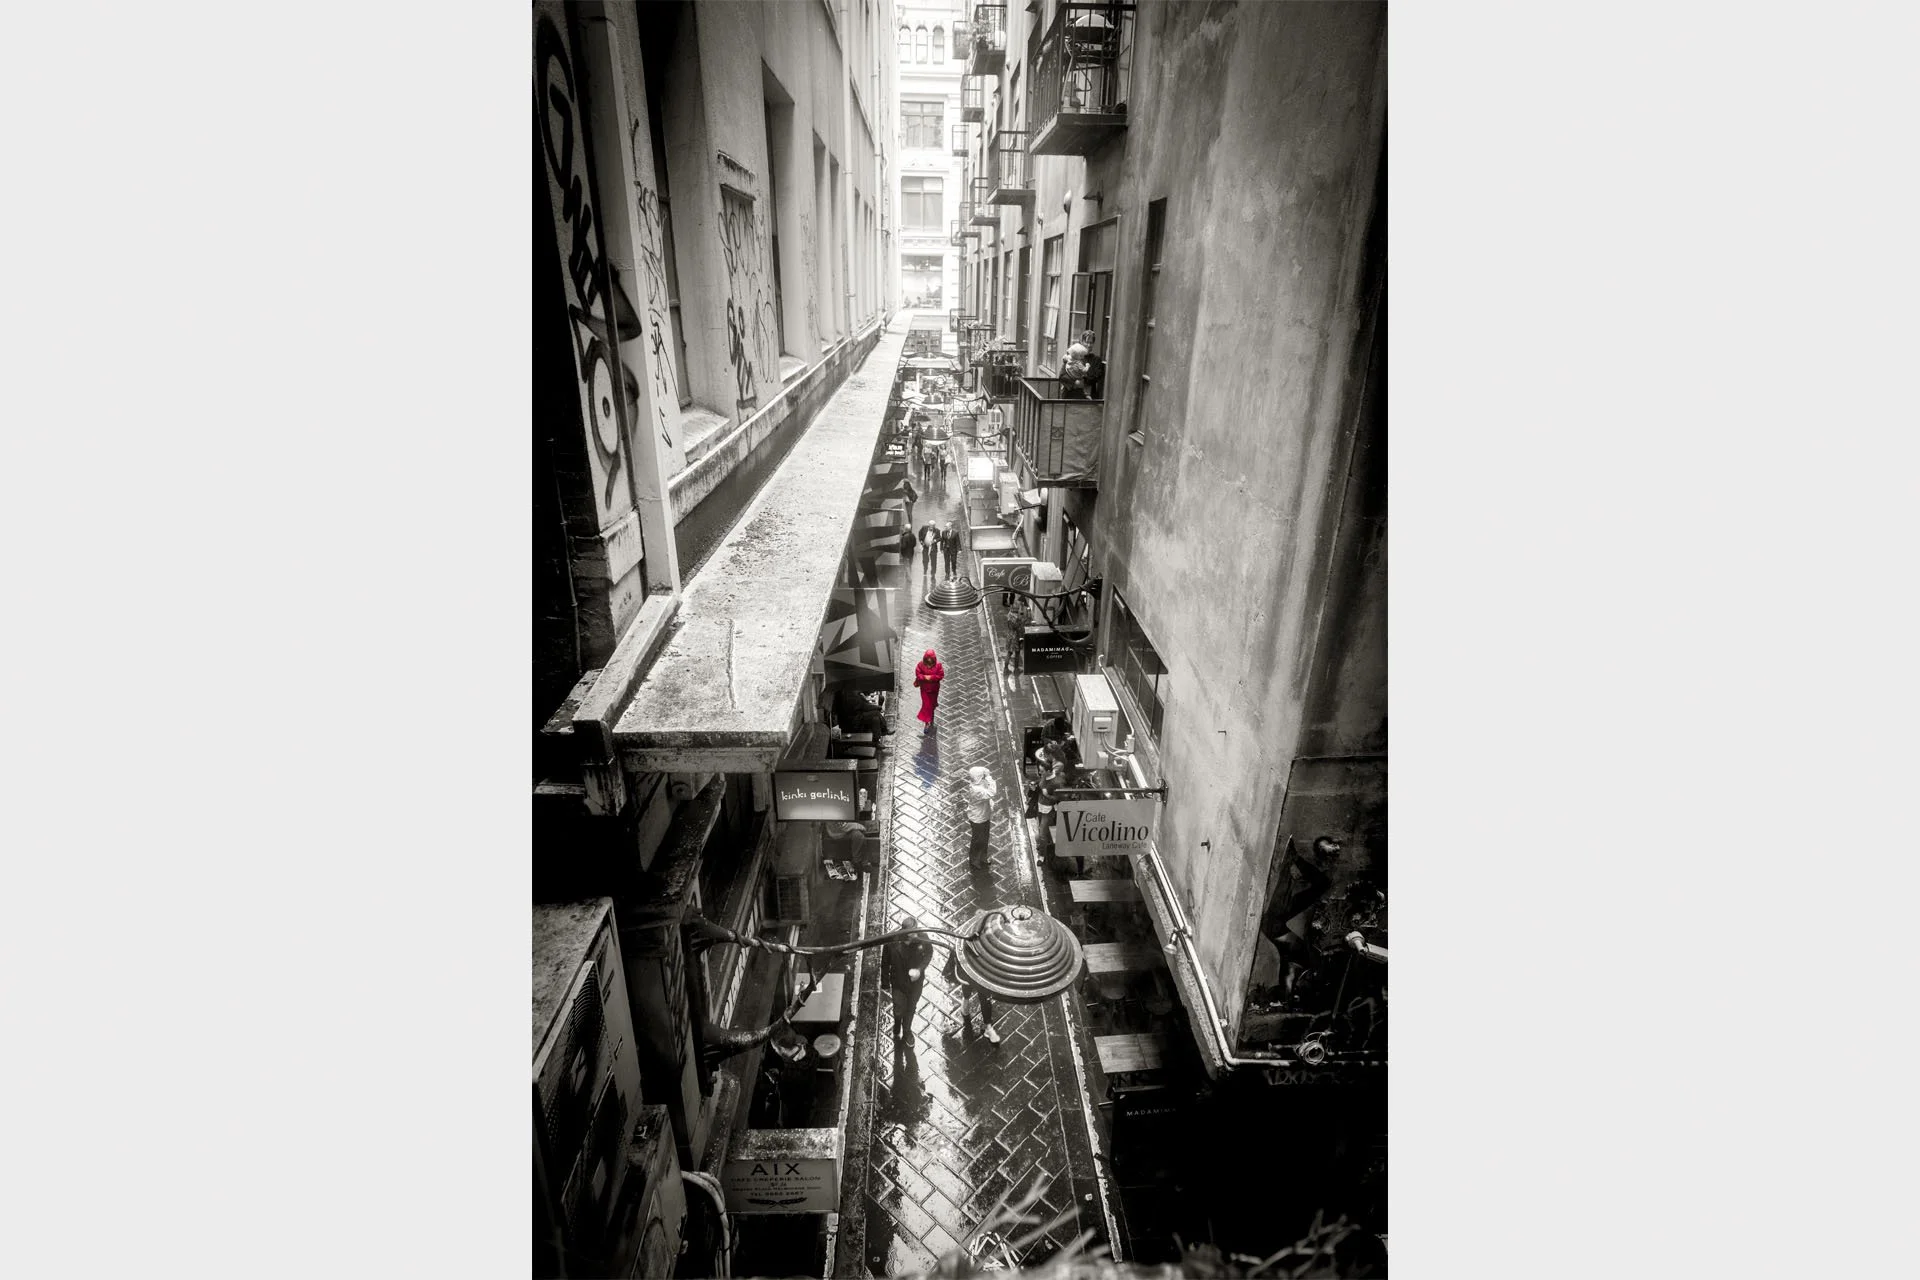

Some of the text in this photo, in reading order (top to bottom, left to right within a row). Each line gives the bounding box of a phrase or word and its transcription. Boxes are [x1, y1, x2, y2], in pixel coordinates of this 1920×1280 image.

[781, 788, 807, 801] kinki
[1085, 813, 1106, 823] Cafe
[1062, 811, 1149, 842] Vicolino
[751, 1163, 800, 1176] AIX
